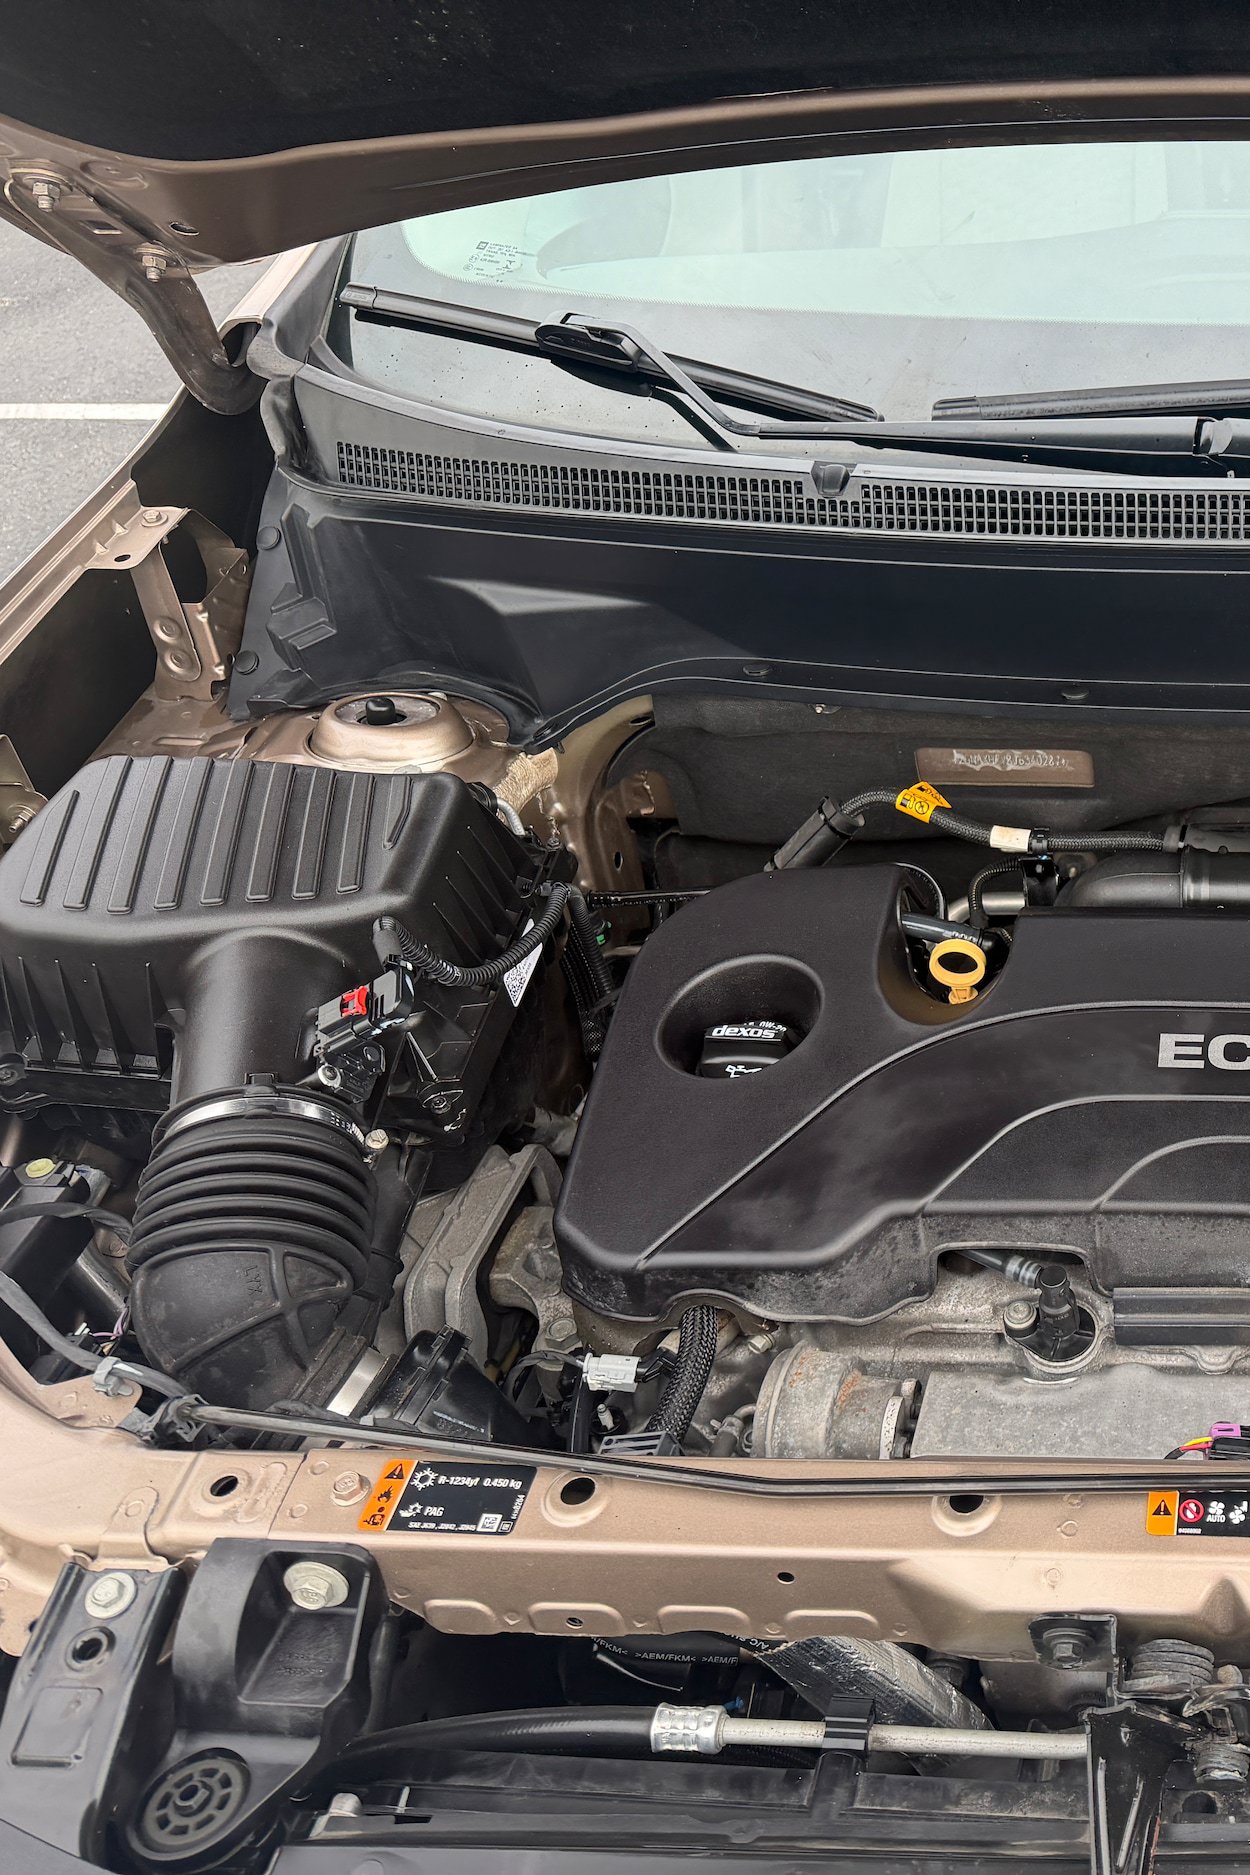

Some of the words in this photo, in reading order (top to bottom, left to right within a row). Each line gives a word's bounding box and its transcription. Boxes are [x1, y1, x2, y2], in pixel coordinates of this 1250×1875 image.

[711, 1024, 777, 1039] dexos
[437, 1475, 480, 1488] R-1234yf
[483, 1478, 509, 1488] 0.450
[509, 1479, 523, 1490] kg
[424, 1506, 445, 1517] PAG
[1206, 1514, 1226, 1523] AUTO
[749, 1638, 770, 1650] A/C
[634, 1652, 697, 1662] >AEM/FKM<
